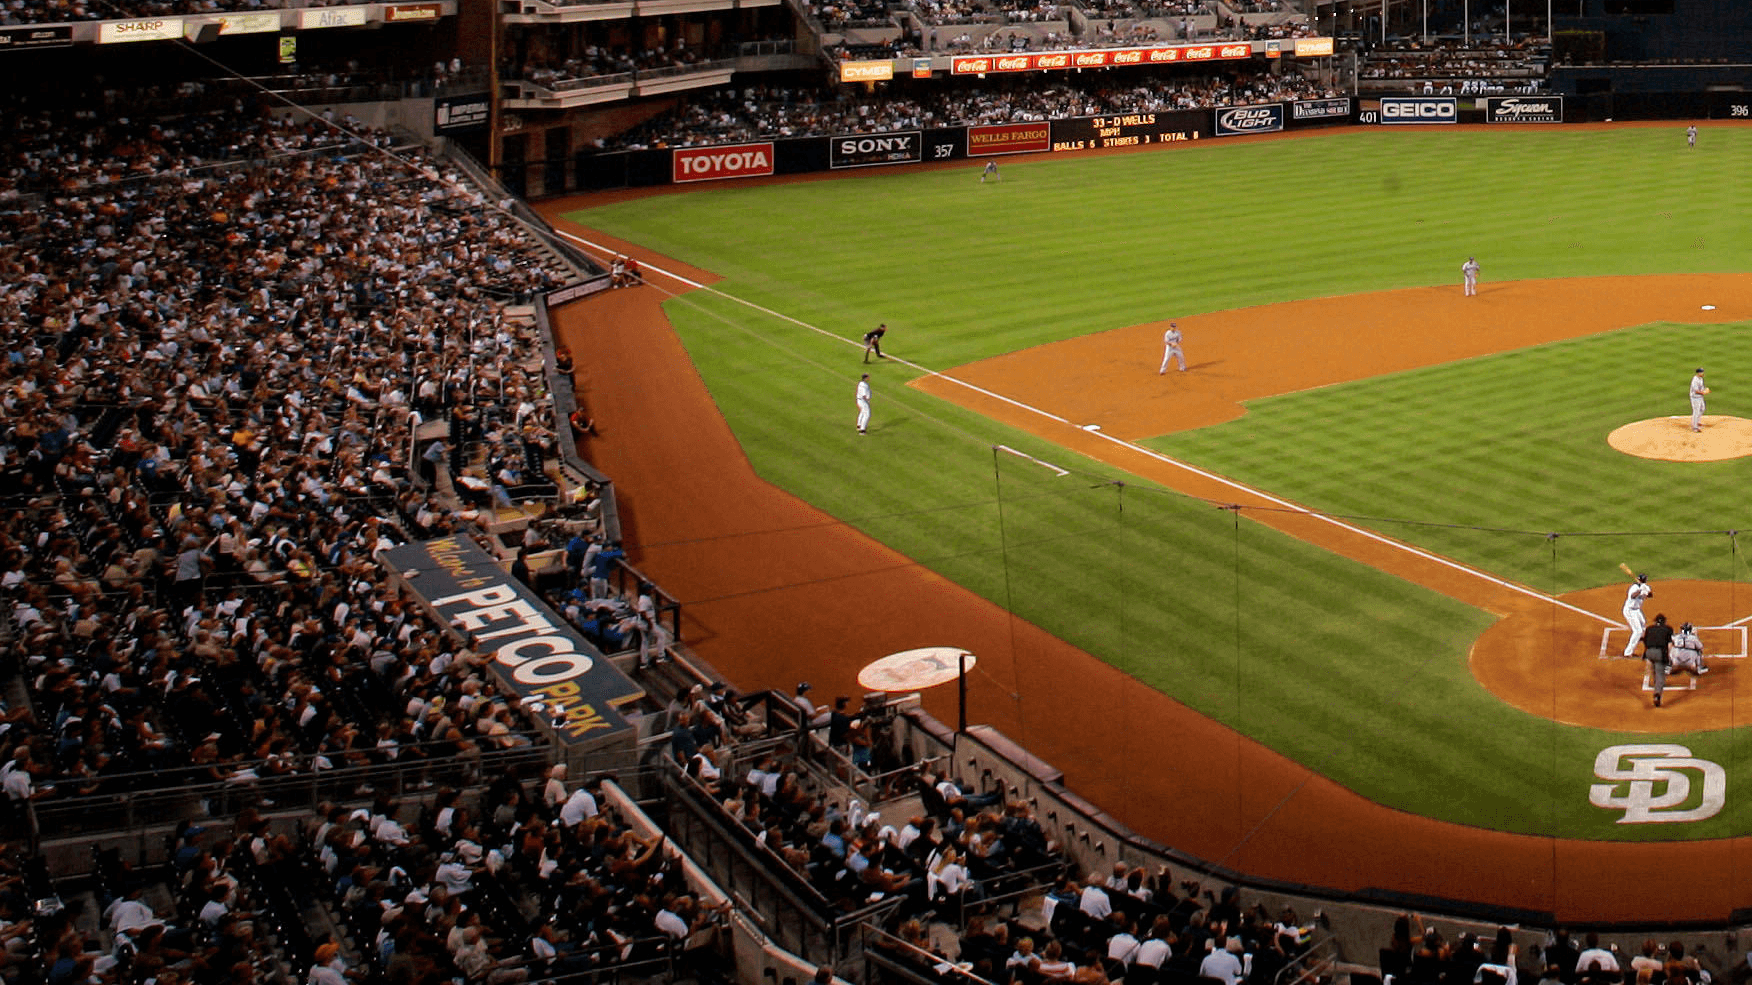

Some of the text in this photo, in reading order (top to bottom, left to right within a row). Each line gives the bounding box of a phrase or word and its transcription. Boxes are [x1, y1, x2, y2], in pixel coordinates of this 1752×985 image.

[320, 11, 347, 26] Aflac
[116, 20, 163, 33] SHARP
[844, 66, 891, 76] CYMER
[1234, 110, 1270, 119] BUD
[1383, 103, 1454, 117] GEICO
[1496, 99, 1553, 118] Sycuan
[1731, 105, 1748, 116] 396
[1093, 114, 1155, 128] 33 D WELLS
[1229, 117, 1277, 128] LIGHT
[1360, 112, 1376, 123] 401
[971, 129, 1047, 145] WELLS FARGO
[1100, 128, 1120, 137] MPH
[841, 137, 908, 154] SONY
[1054, 133, 1188, 151] BALLS STRIKES TOTAL
[934, 144, 953, 157] 357
[681, 152, 768, 174] TOYOTA
[426, 537, 494, 588] Welcome to
[431, 583, 593, 685] PETCO
[528, 681, 612, 738] PARK
[1589, 743, 1726, 824] SD
